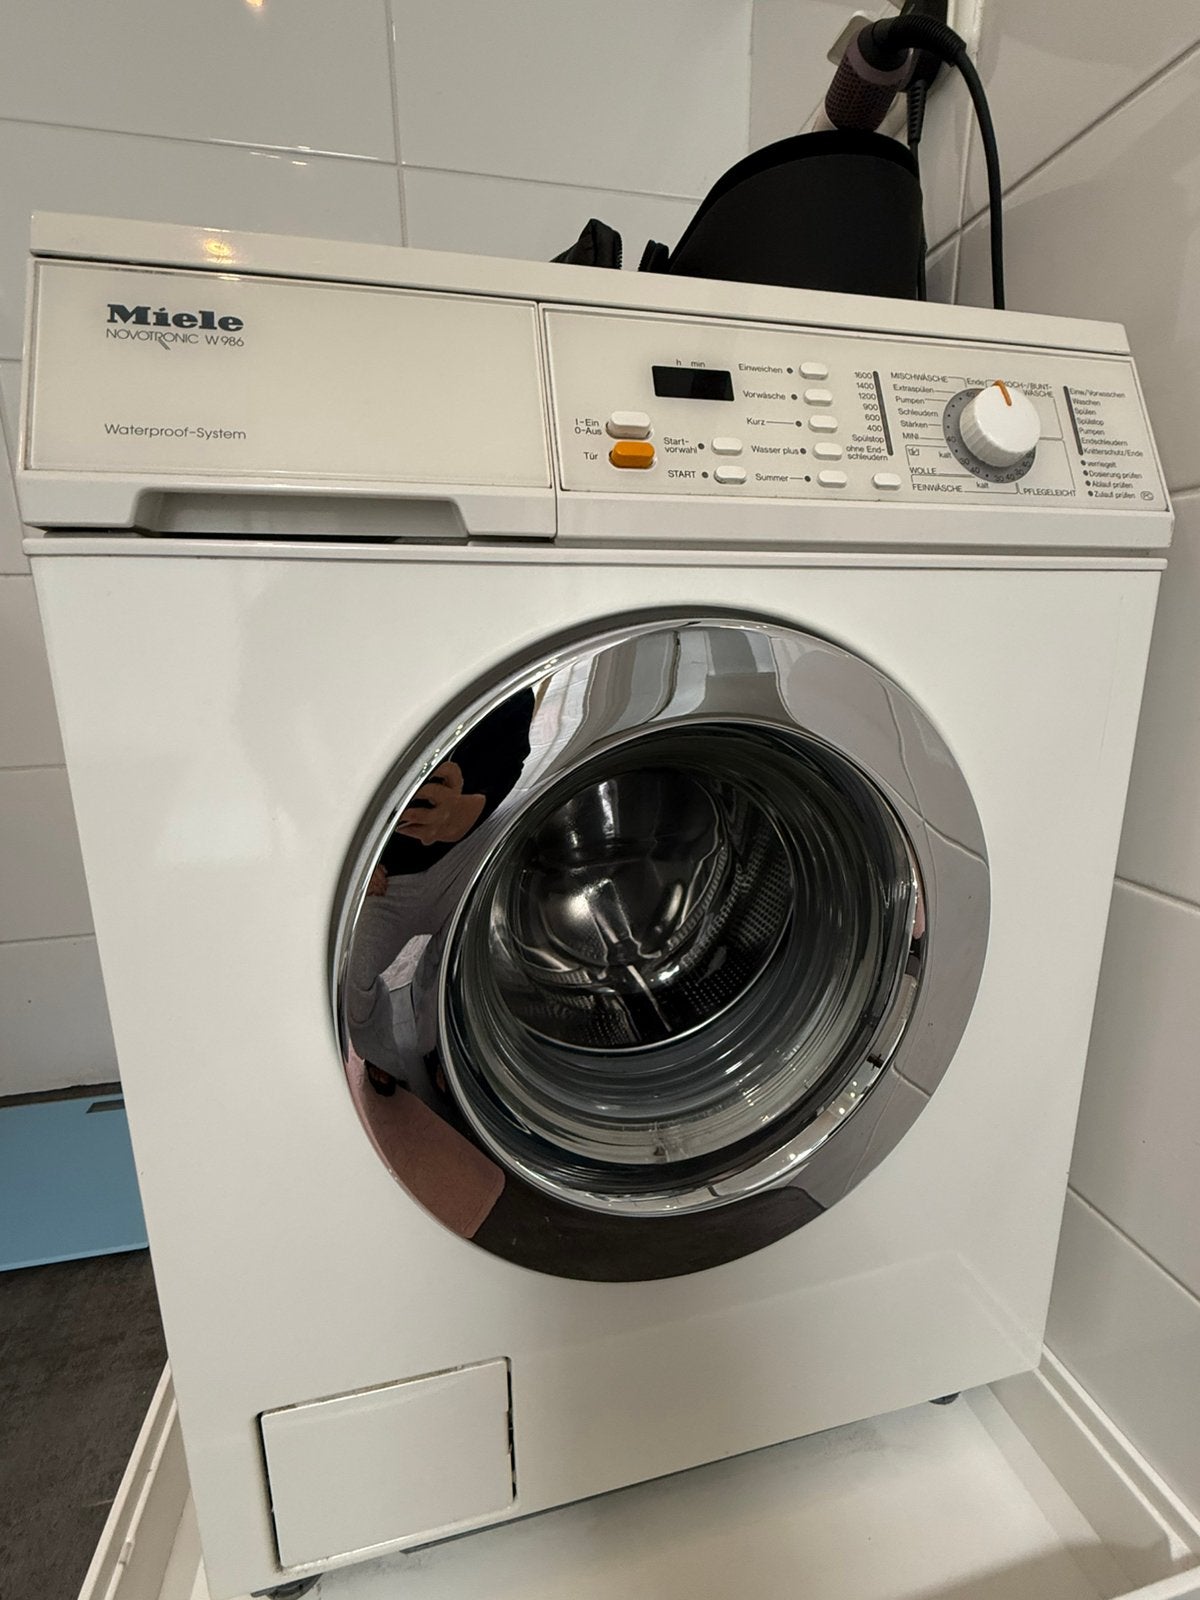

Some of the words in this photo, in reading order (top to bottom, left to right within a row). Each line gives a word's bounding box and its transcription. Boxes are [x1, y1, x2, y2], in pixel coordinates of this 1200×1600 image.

[107, 303, 244, 331] Miele
[106, 328, 199, 350] NOVOTRONIC
[738, 363, 783, 374] Einweichen
[854, 371, 873, 380] 1600
[890, 372, 948, 383] MISCHWÄSCHE
[856, 381, 875, 390] 1400
[893, 384, 935, 394] Extraspülen
[742, 389, 787, 401] Vorwäsche
[858, 392, 877, 401] 1200
[895, 395, 926, 406] Pumpen
[1072, 398, 1102, 407] Waschen
[862, 403, 879, 411] 900
[864, 413, 881, 422] 600
[897, 407, 939, 418] Schleudern
[746, 417, 766, 426] Kurz
[900, 419, 929, 429] Stärken
[104, 423, 247, 440] Waterproof-System
[866, 424, 883, 433] 400
[1078, 427, 1106, 437] Pumpen
[663, 436, 690, 446] Start-
[851, 433, 885, 444] Spülstop
[902, 432, 920, 440] MINI
[664, 445, 698, 455] vorwahl
[751, 445, 781, 454] Wasser
[782, 446, 800, 456] plus
[845, 445, 865, 454] ohne
[866, 445, 886, 454] End-
[584, 451, 599, 461] Tür
[847, 452, 889, 462] schleudern
[667, 469, 696, 479] START
[909, 466, 937, 475] WOLLE
[755, 472, 789, 482] Summer
[912, 482, 963, 493] FEINWÄSCHE
[1023, 488, 1077, 497] PFLEGELEICHT
